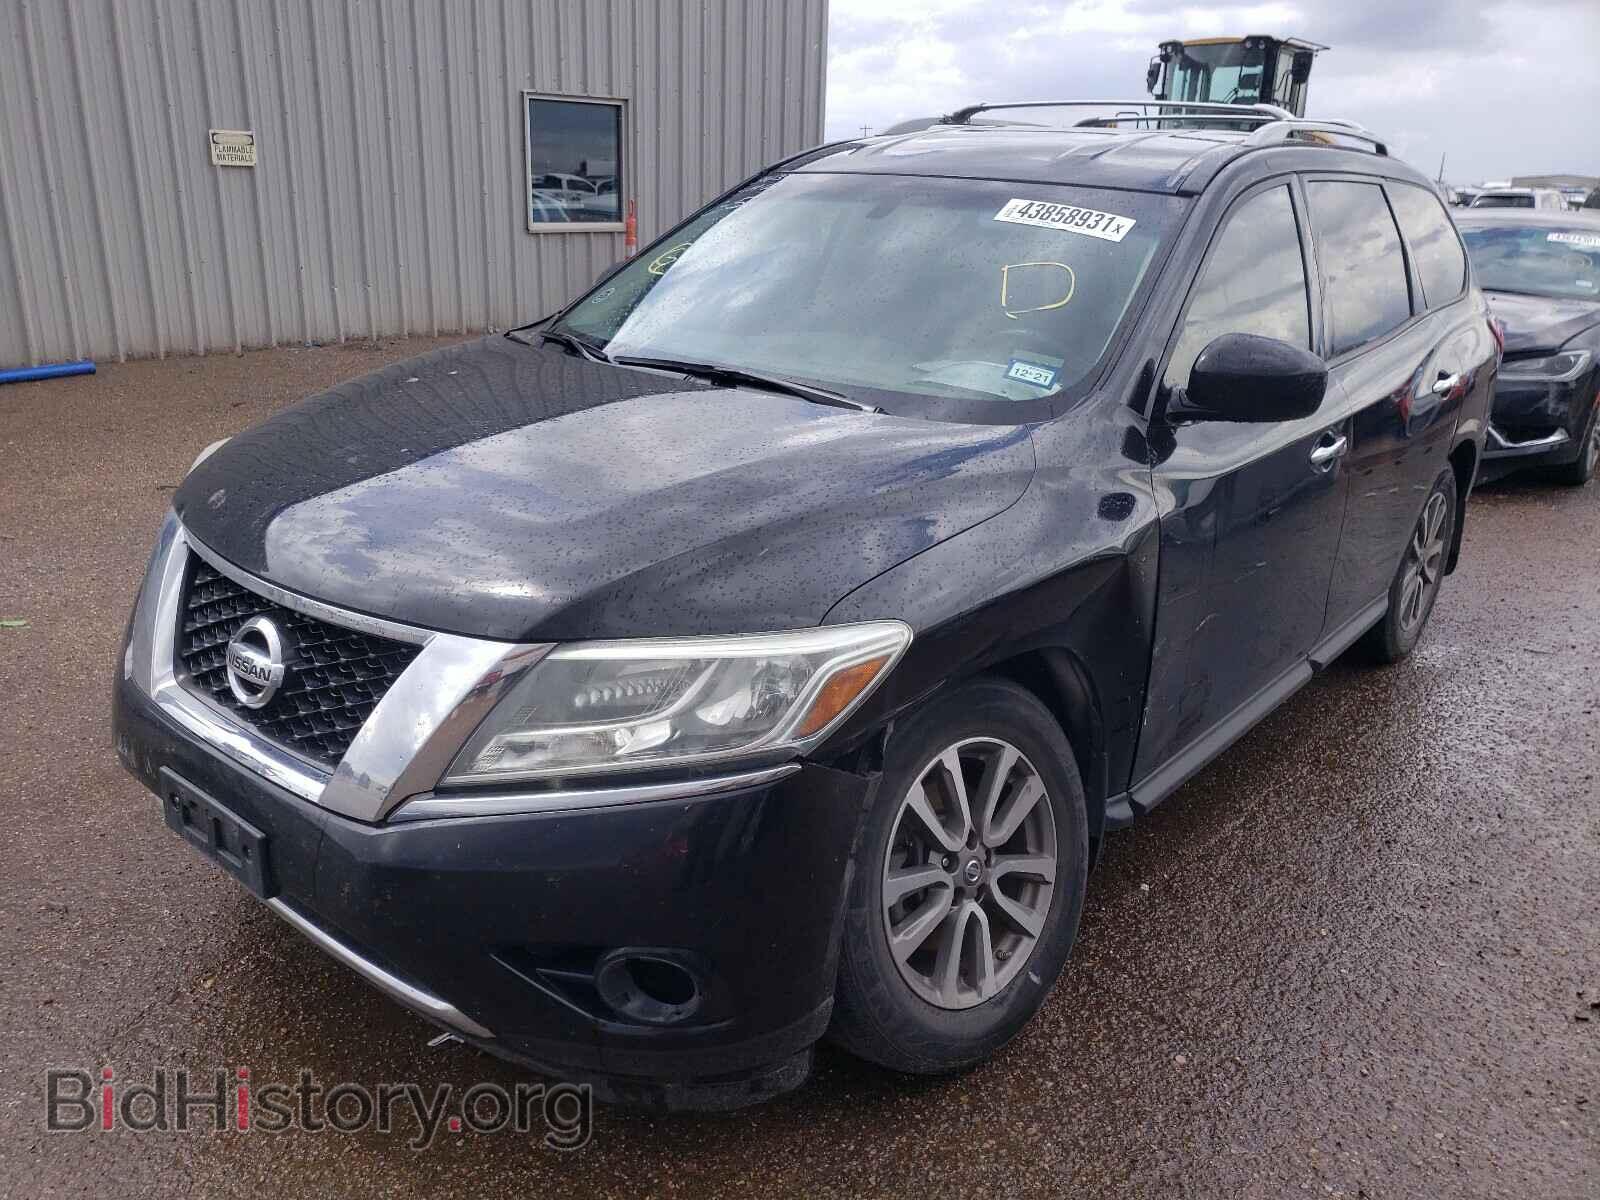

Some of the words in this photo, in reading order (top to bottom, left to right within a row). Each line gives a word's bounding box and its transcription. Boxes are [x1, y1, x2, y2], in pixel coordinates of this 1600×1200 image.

[214, 145, 254, 154] FLAMMABLE
[216, 153, 253, 162] MATERIALS
[227, 649, 272, 682] NISSAN
